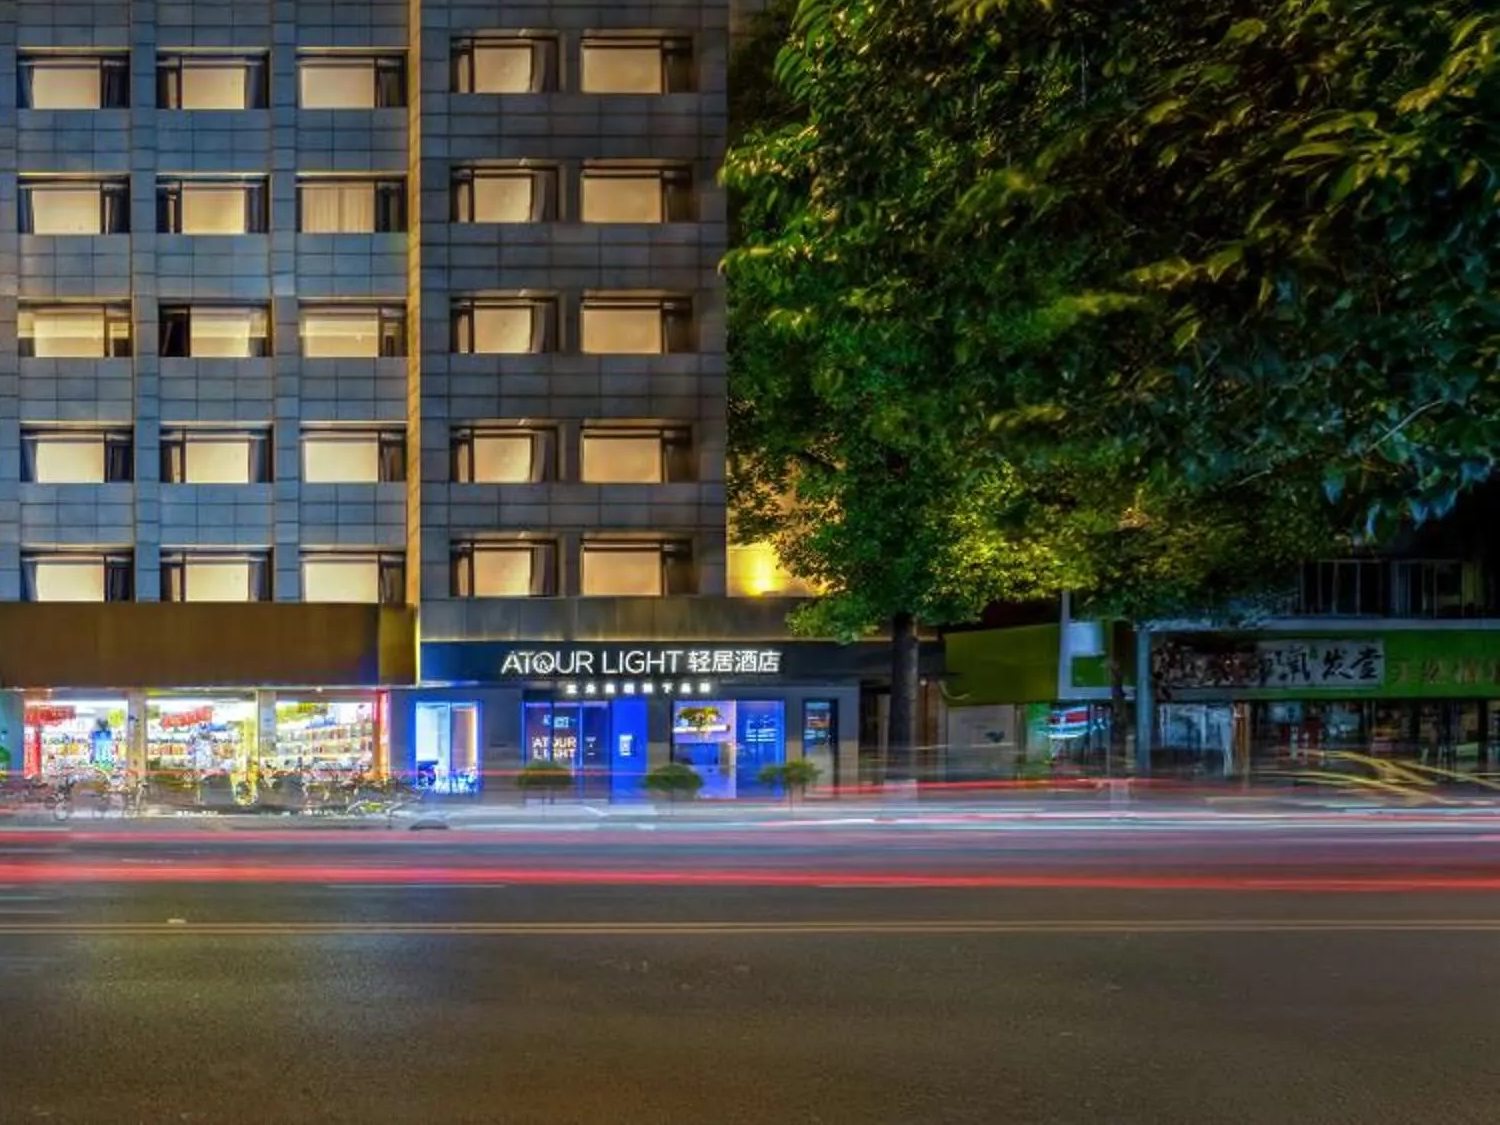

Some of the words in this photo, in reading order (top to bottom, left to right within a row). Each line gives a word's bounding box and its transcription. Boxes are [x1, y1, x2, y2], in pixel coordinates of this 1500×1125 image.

[501, 650, 594, 674] ATOUR
[602, 650, 683, 674] LIGHT
[687, 650, 782, 673] 轻居酒店
